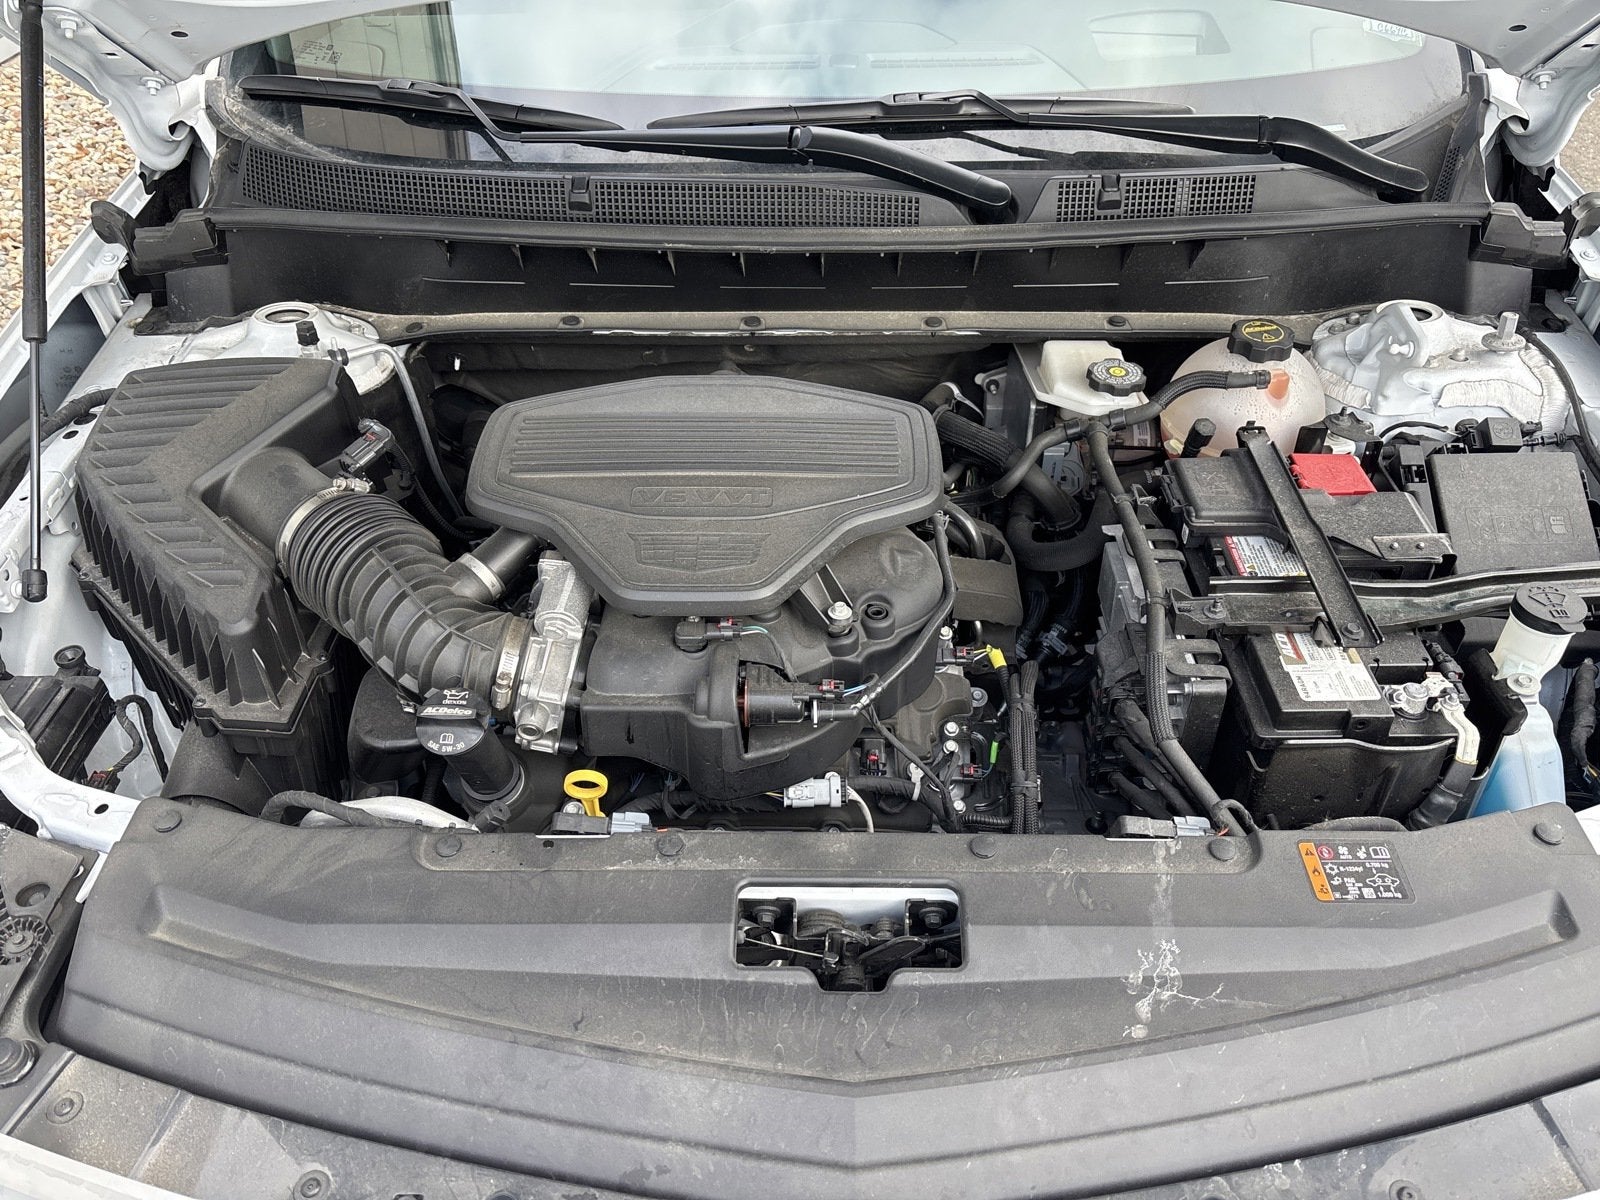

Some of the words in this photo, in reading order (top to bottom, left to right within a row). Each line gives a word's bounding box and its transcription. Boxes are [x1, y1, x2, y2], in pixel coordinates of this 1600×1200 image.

[420, 706, 473, 716] ACDelco
[427, 740, 440, 751] SAE
[441, 741, 465, 752] 5W-30
